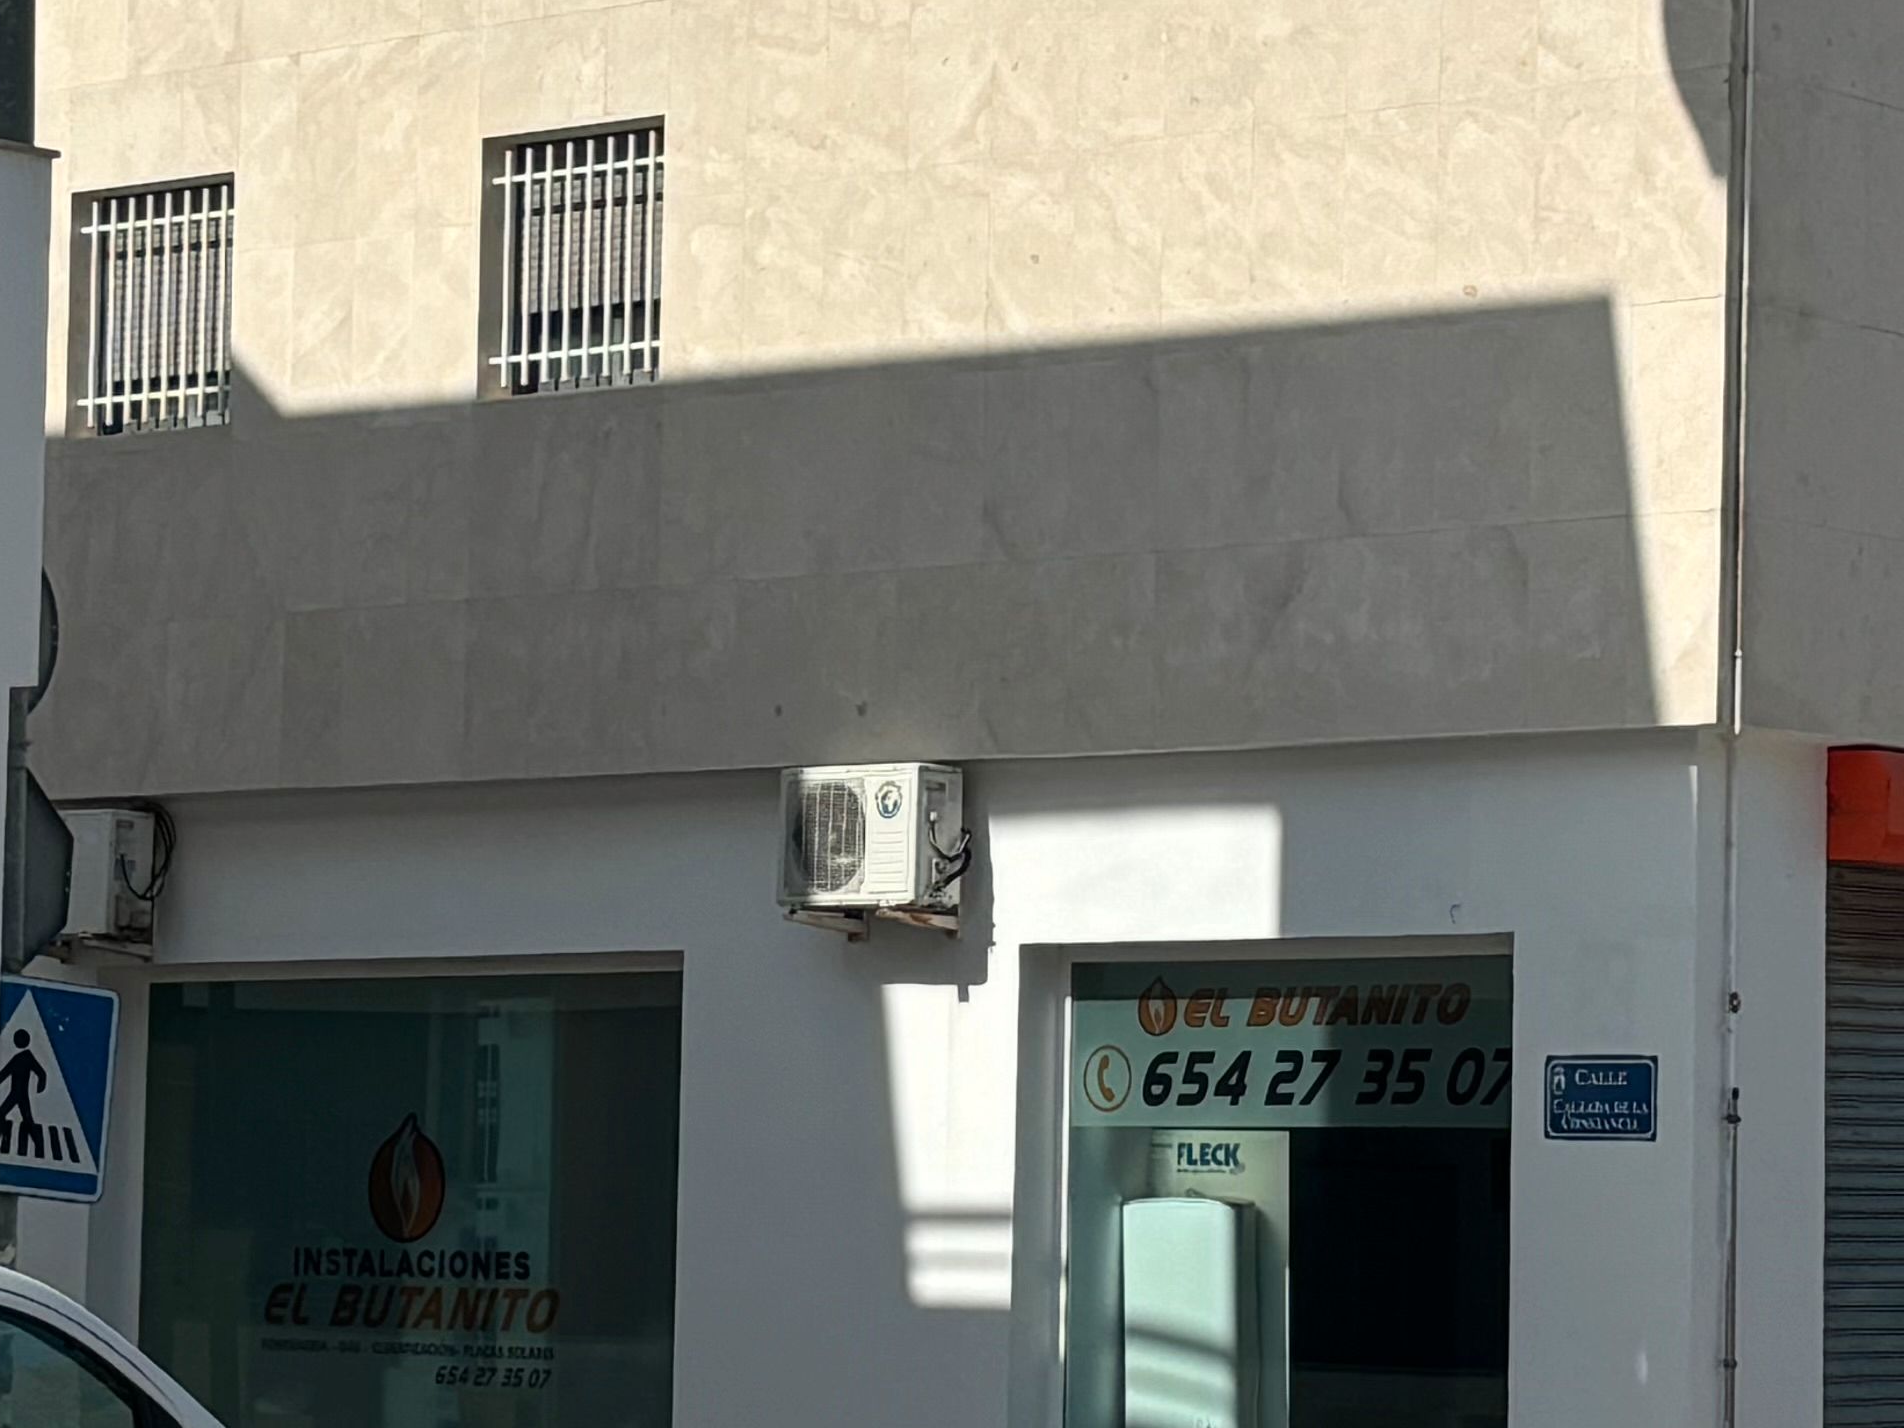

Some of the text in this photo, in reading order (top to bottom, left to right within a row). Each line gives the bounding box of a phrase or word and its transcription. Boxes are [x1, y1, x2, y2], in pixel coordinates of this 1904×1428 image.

[1184, 983, 1471, 1027] EL BUTANITO
[1142, 1047, 1512, 1106] 654 27 35 07
[1177, 1142, 1240, 1167] FLECK
[295, 1246, 530, 1280] INSTALACIONES
[264, 1283, 560, 1333] EL BUTANITO
[435, 1366, 552, 1389] 654 27 35 07
